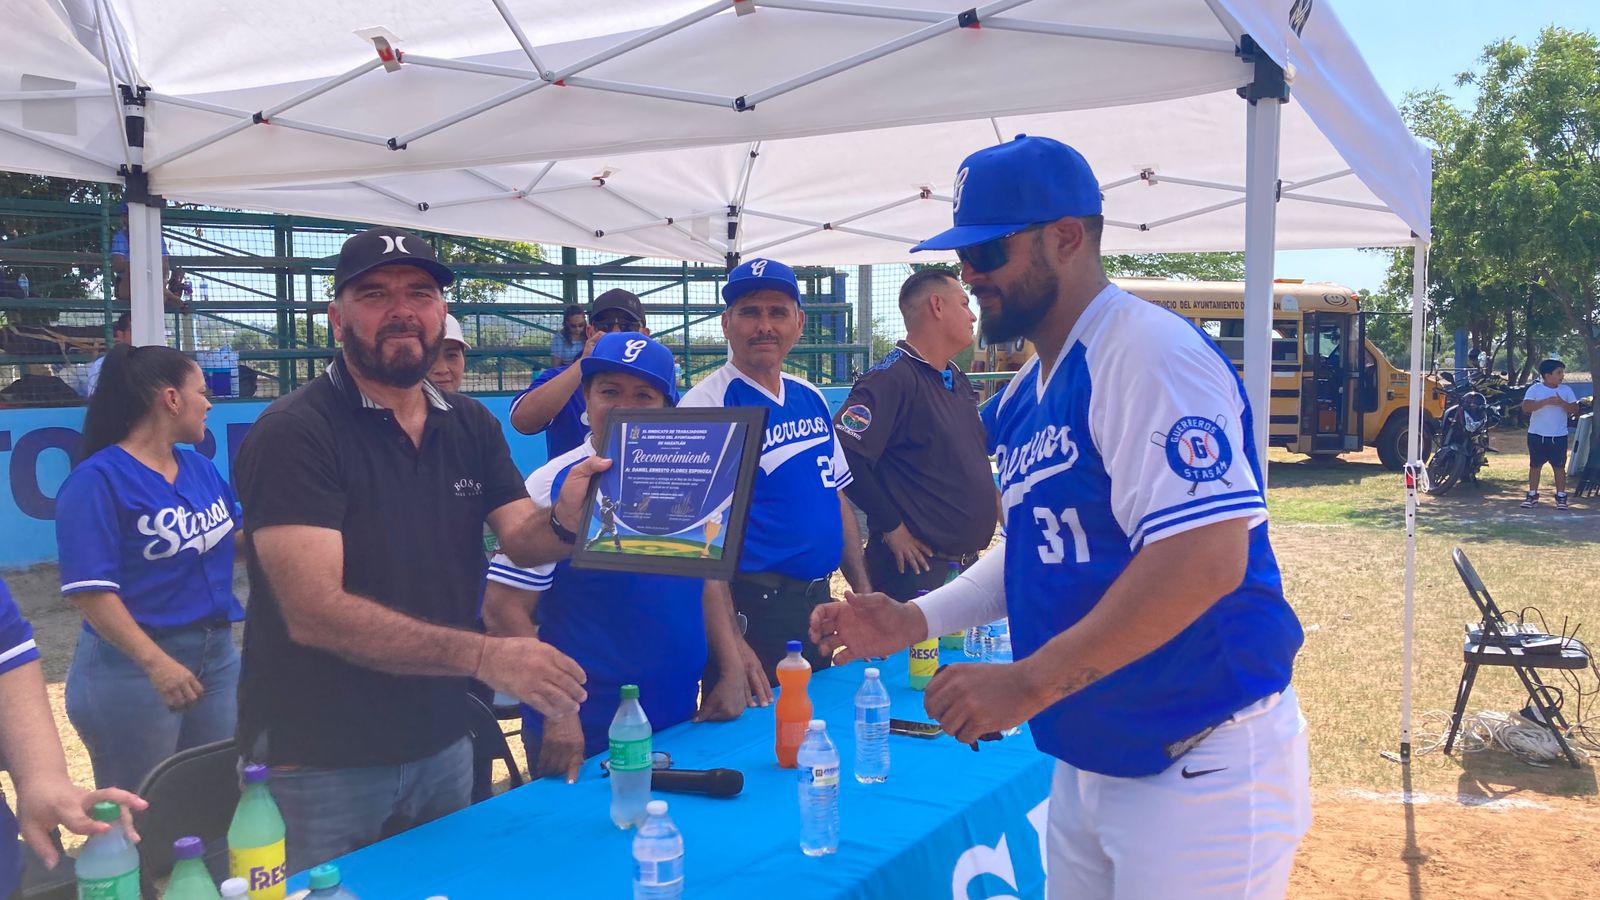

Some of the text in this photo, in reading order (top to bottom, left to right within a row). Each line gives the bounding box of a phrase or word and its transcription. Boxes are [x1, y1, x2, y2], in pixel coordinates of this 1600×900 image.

[1180, 300, 1192, 309] DEL
[1193, 300, 1240, 309] AYUNTAMIENTO
[1170, 418, 1217, 443] GUERREROS
[632, 448, 711, 465] Reconocimiento
[1190, 436, 1208, 459] G
[1184, 460, 1227, 479] STASAM
[454, 478, 482, 491] BOSS
[1033, 506, 1091, 565] 31
